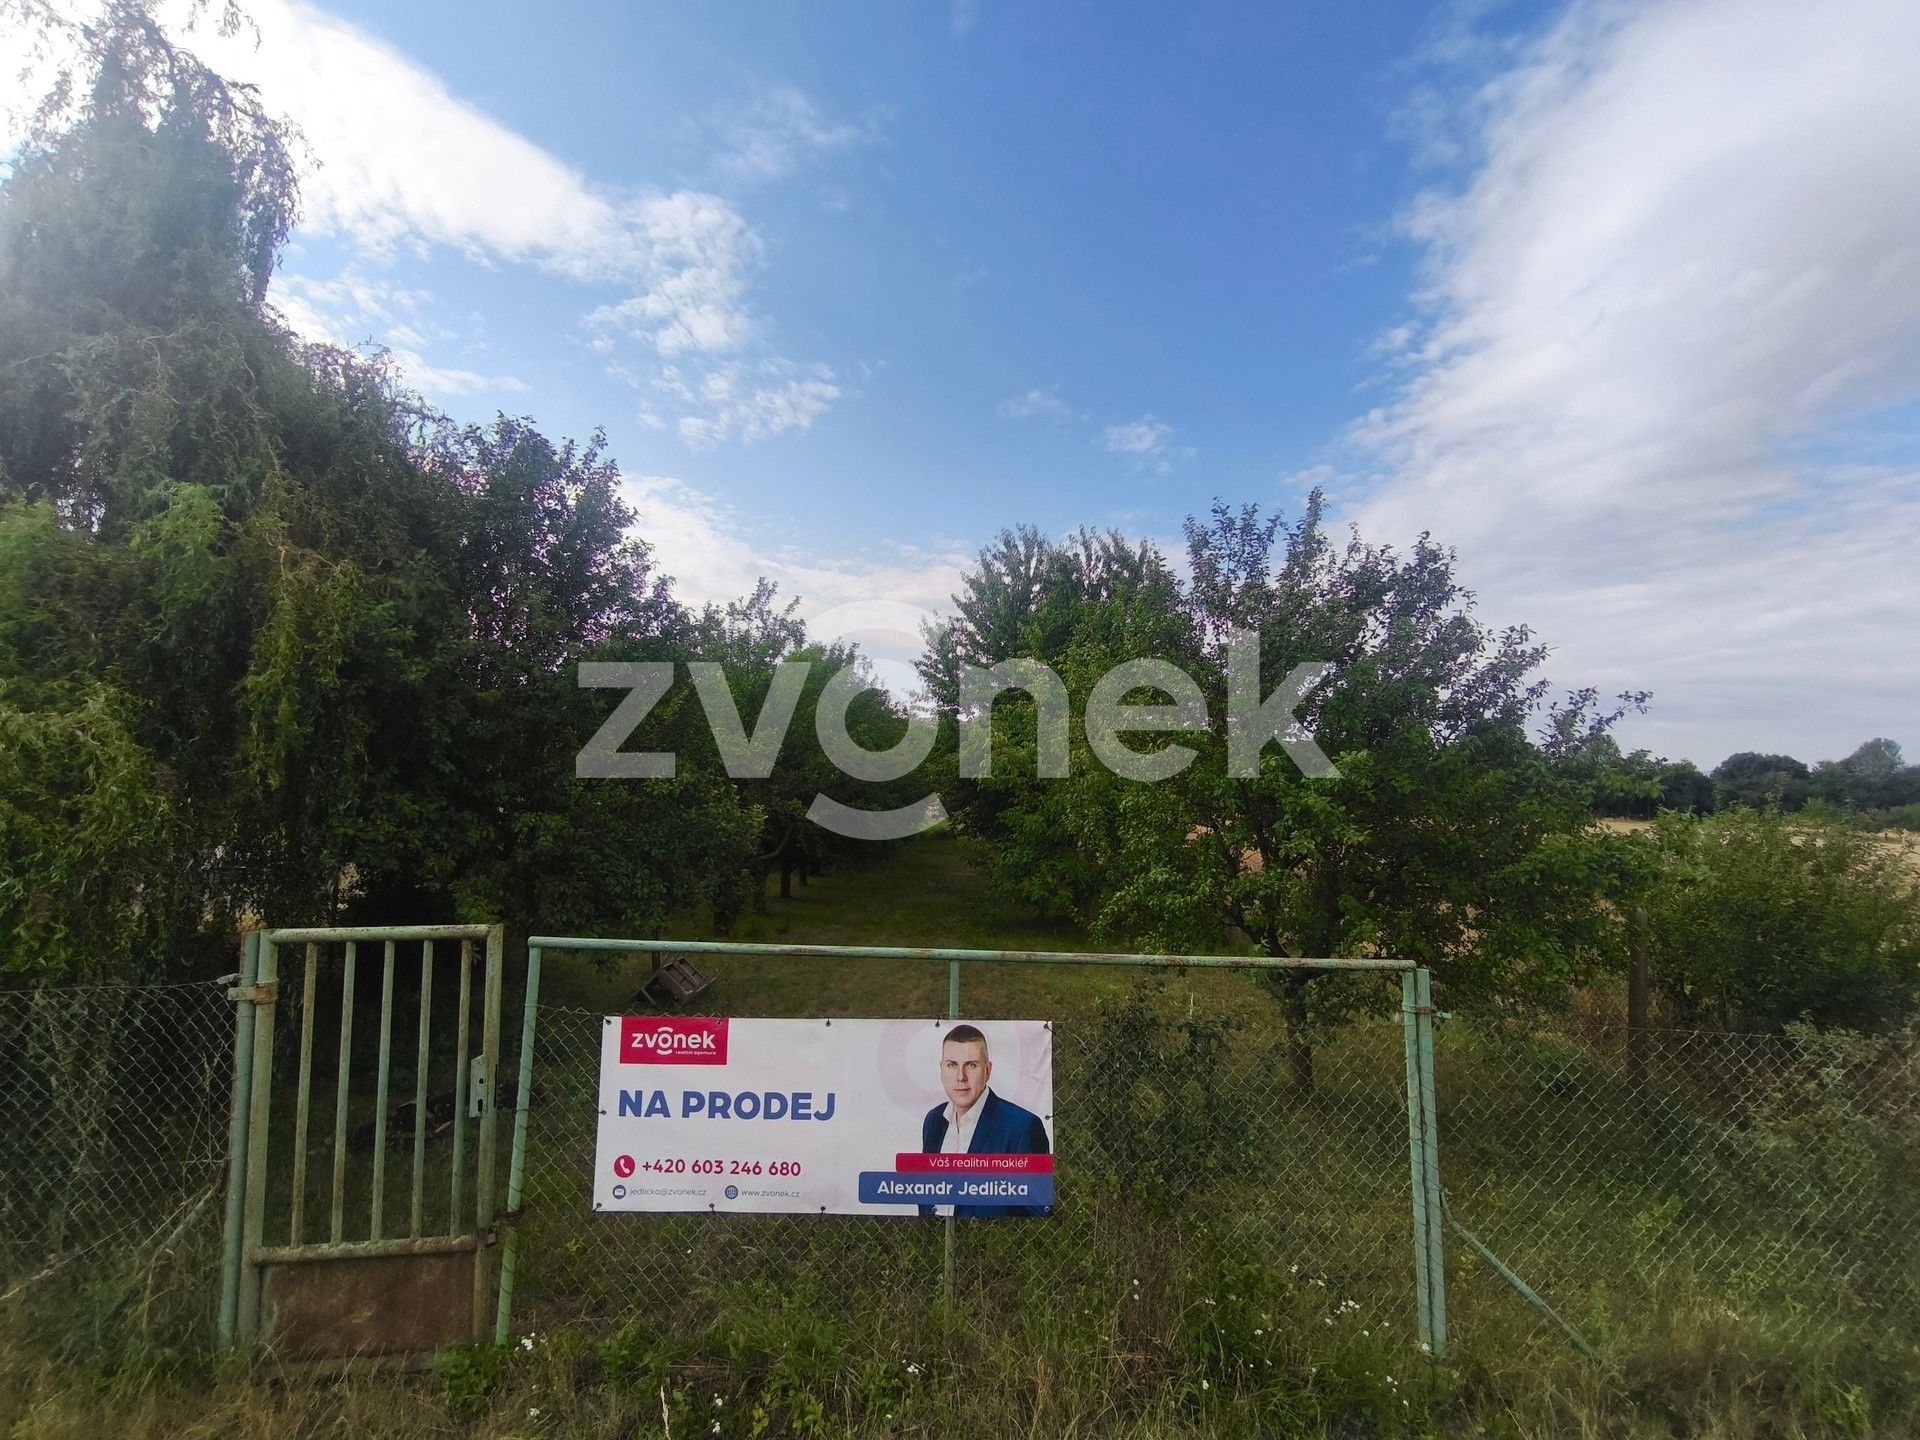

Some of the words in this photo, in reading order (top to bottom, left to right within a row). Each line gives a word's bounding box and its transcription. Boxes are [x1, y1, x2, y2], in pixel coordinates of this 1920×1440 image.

[631, 1031, 716, 1050] zvonek
[618, 1089, 671, 1118] NA
[682, 1090, 836, 1121] PRODEJ
[642, 1158, 686, 1173] +420
[691, 1159, 724, 1174] 603
[730, 1160, 763, 1175] 246
[768, 1161, 801, 1176] 680
[929, 1157, 950, 1168] Váš
[952, 1157, 989, 1168] realitní
[991, 1157, 1029, 1168] makléř
[741, 1189, 800, 1199] www.zvonek.cz
[877, 1180, 953, 1195] Alexandr
[957, 1180, 1029, 1196] Jedlička
